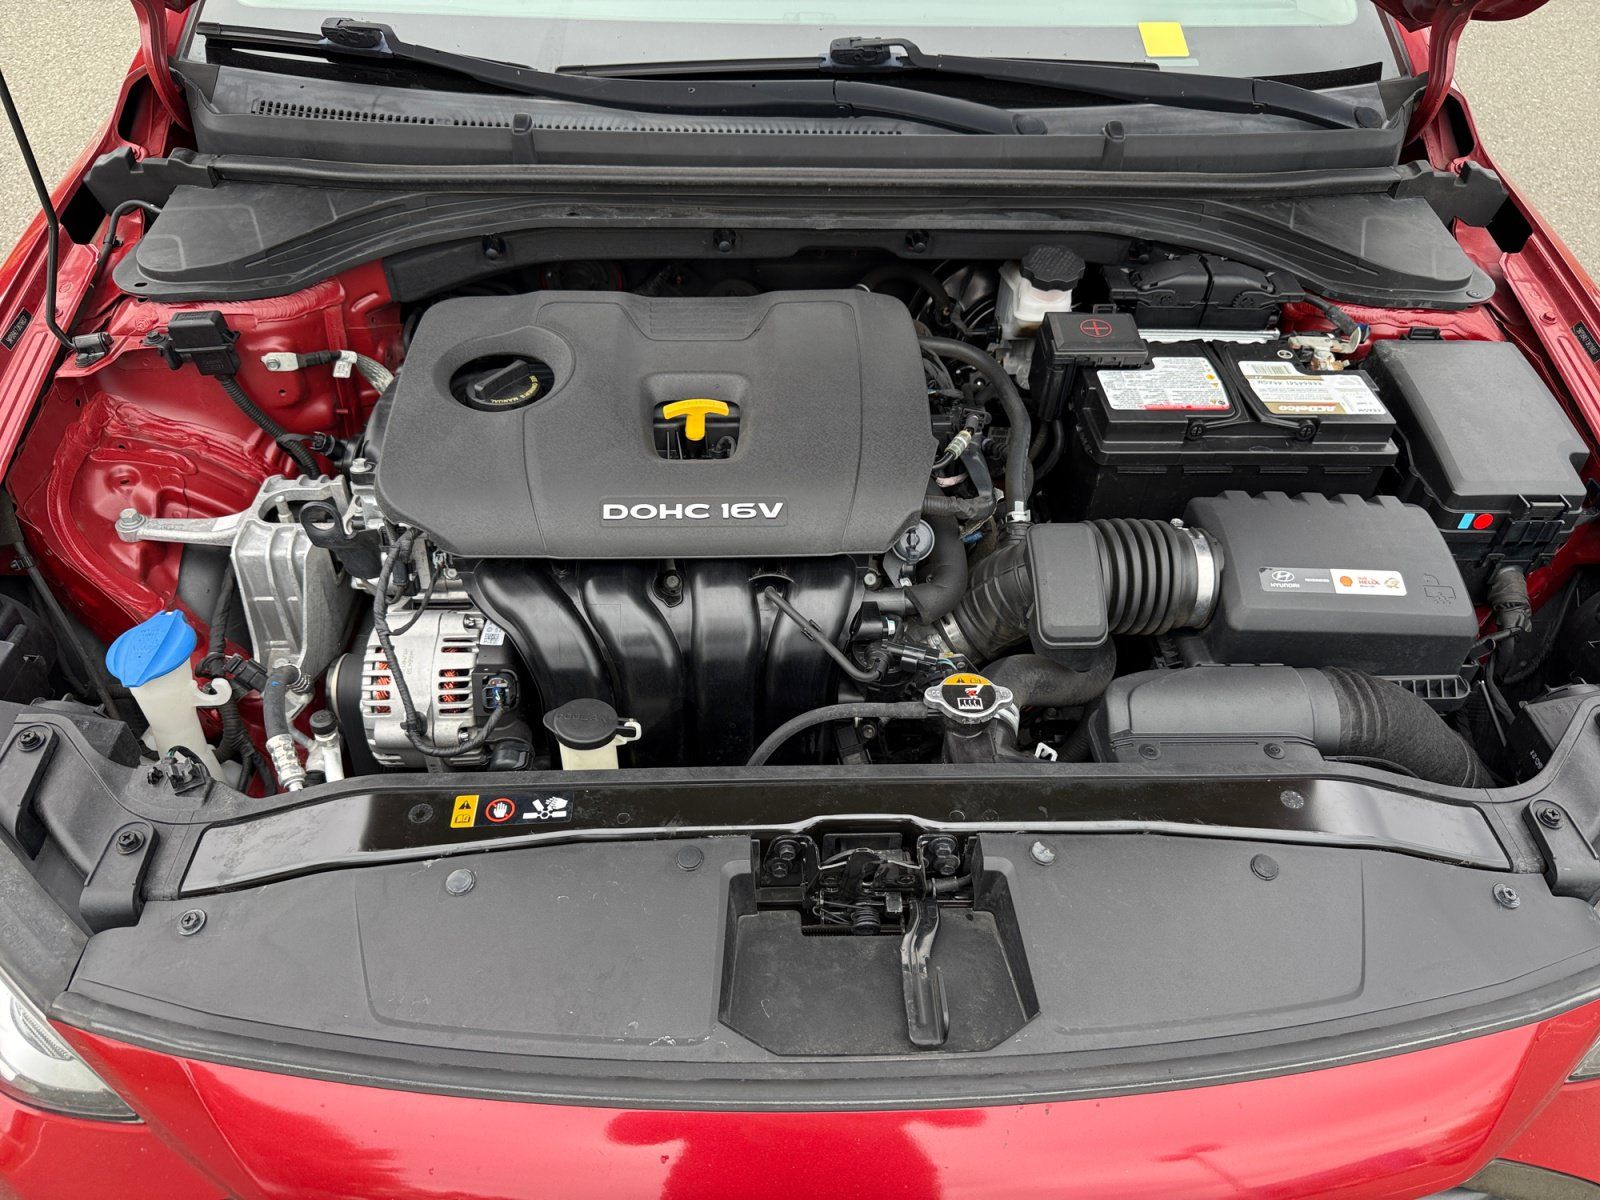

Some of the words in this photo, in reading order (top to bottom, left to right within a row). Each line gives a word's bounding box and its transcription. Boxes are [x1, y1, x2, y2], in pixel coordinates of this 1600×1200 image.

[490, 396, 519, 404] MANUAL
[602, 503, 711, 520] DOHC
[721, 502, 784, 519] 16V
